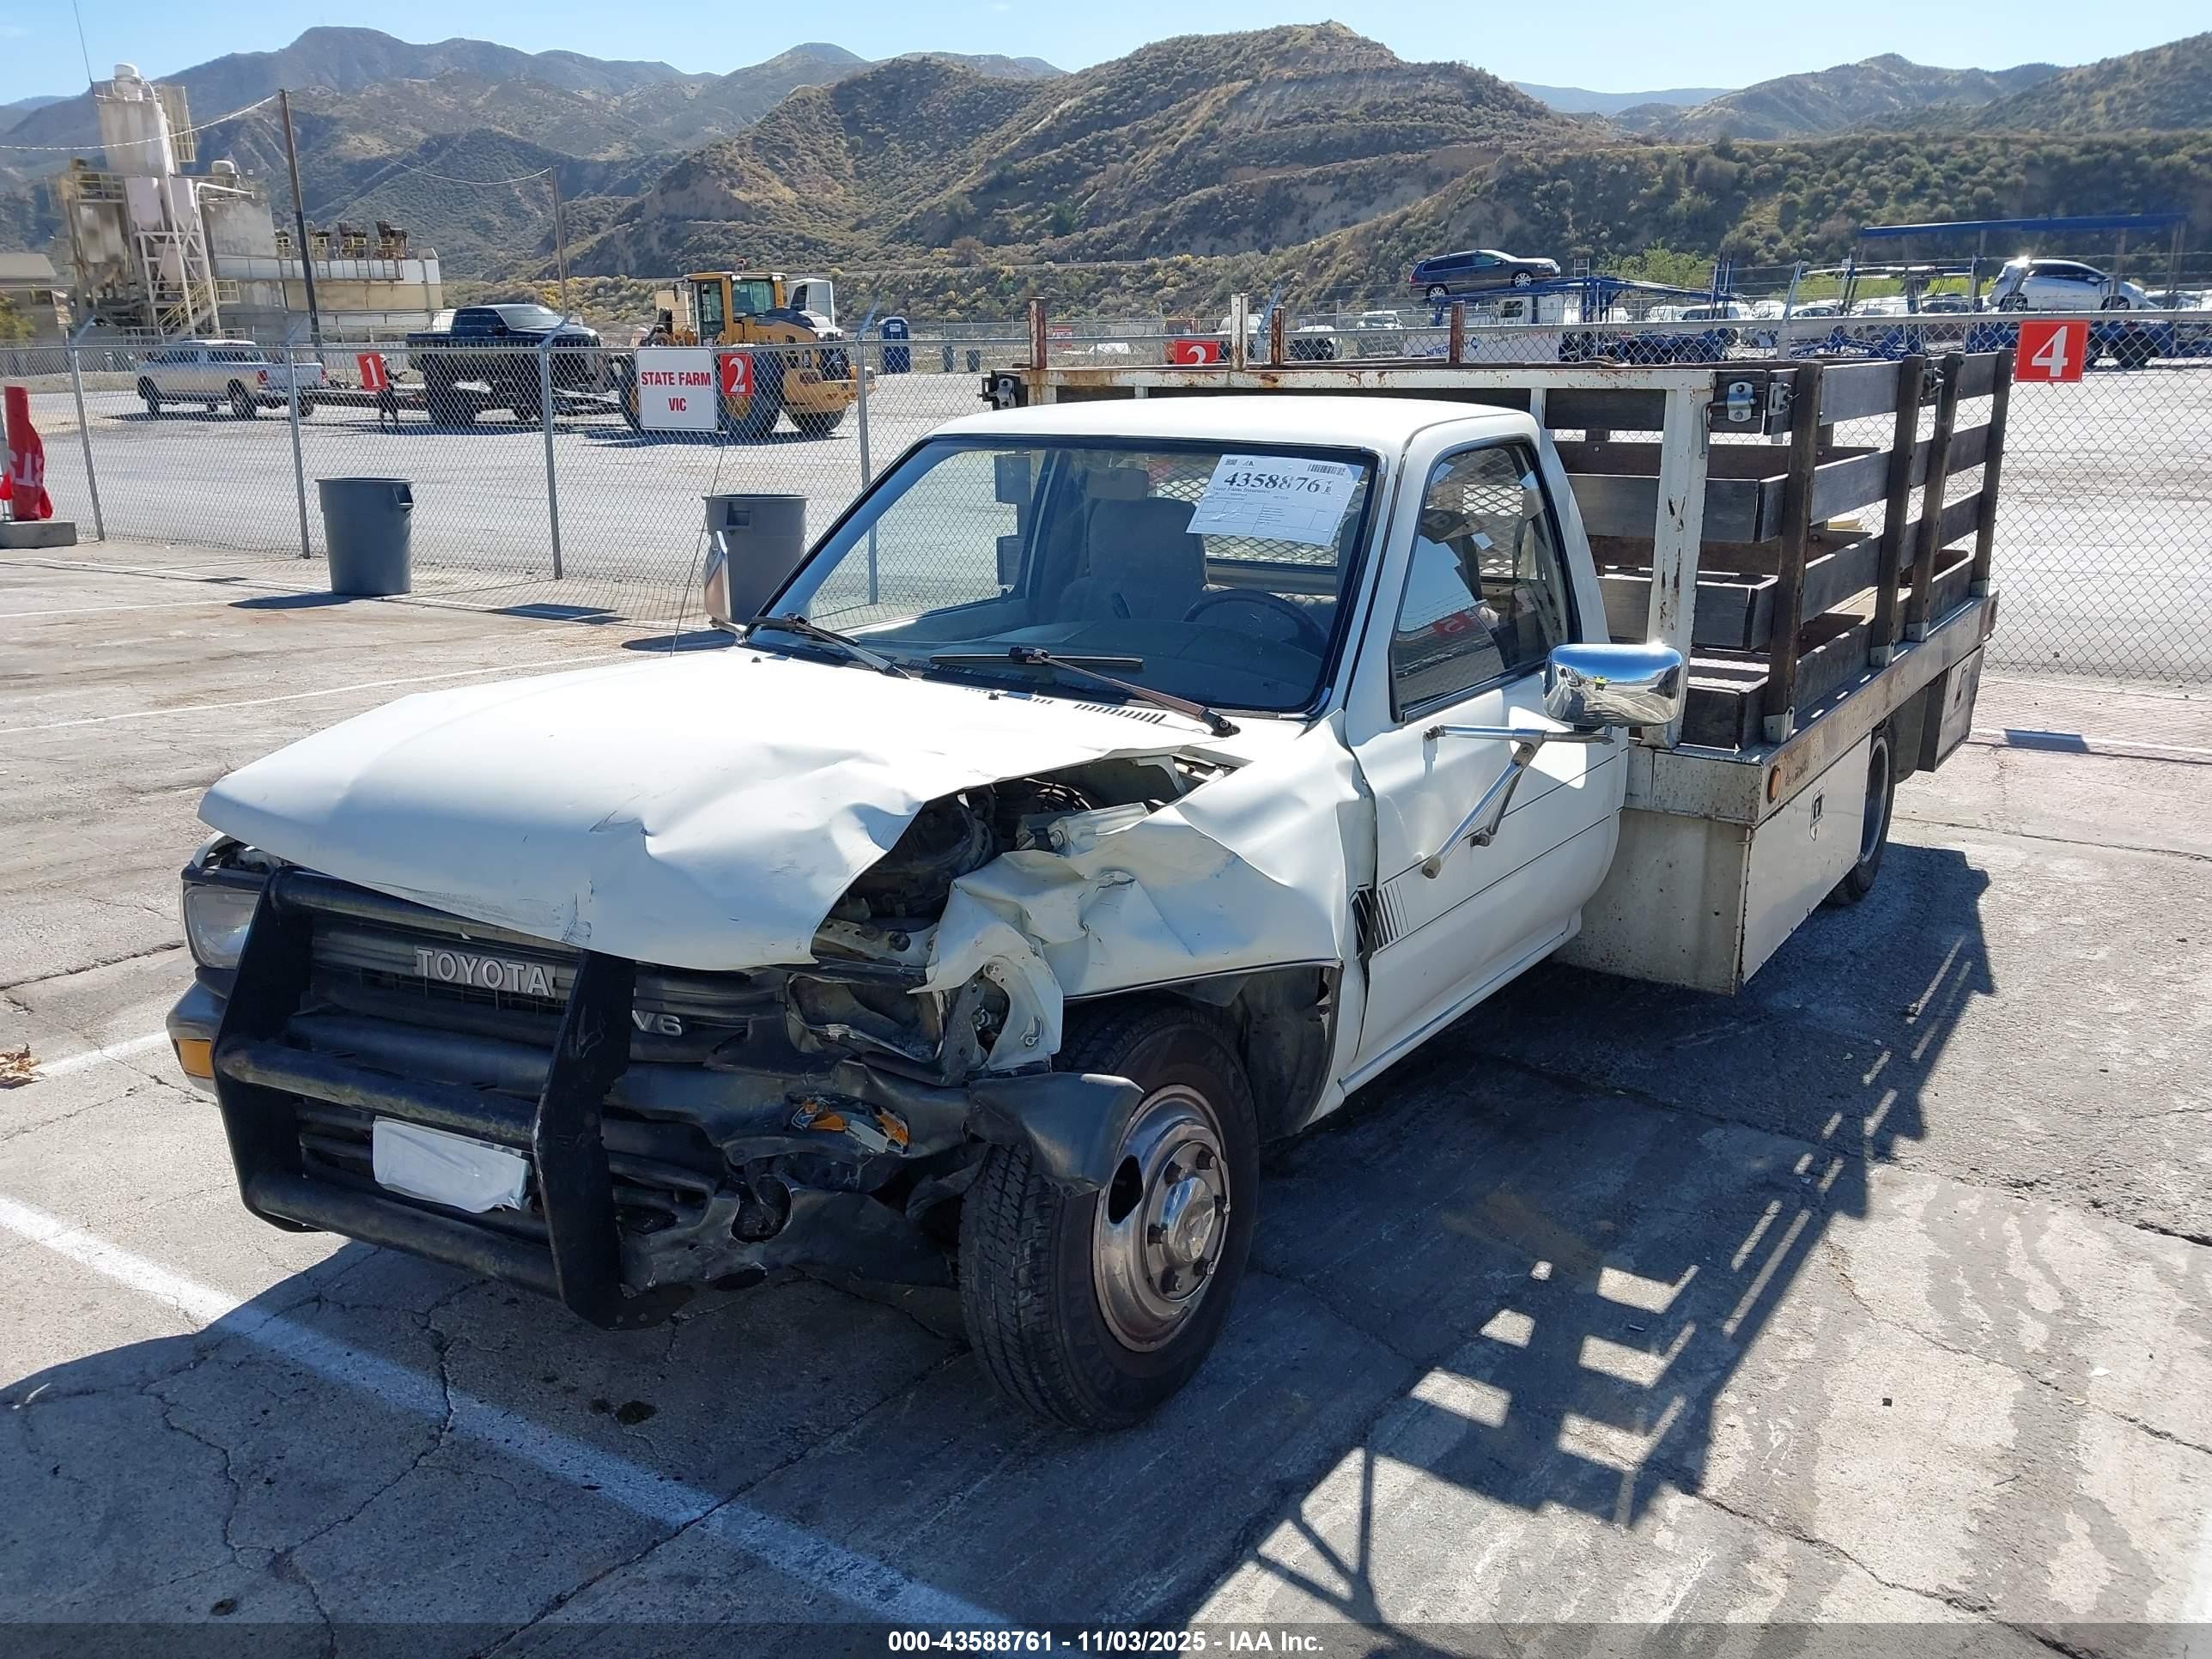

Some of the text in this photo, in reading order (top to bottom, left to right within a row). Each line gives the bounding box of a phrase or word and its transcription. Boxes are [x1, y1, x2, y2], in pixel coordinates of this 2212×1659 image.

[2032, 325, 2068, 377] 4
[365, 357, 381, 387] 1
[641, 372, 711, 386] STATE FARM
[729, 357, 746, 392] 2
[668, 398, 687, 411] VIC
[1224, 471, 1333, 495] 43588761
[416, 949, 550, 997] TOYOTA
[632, 1010, 683, 1036] V6
